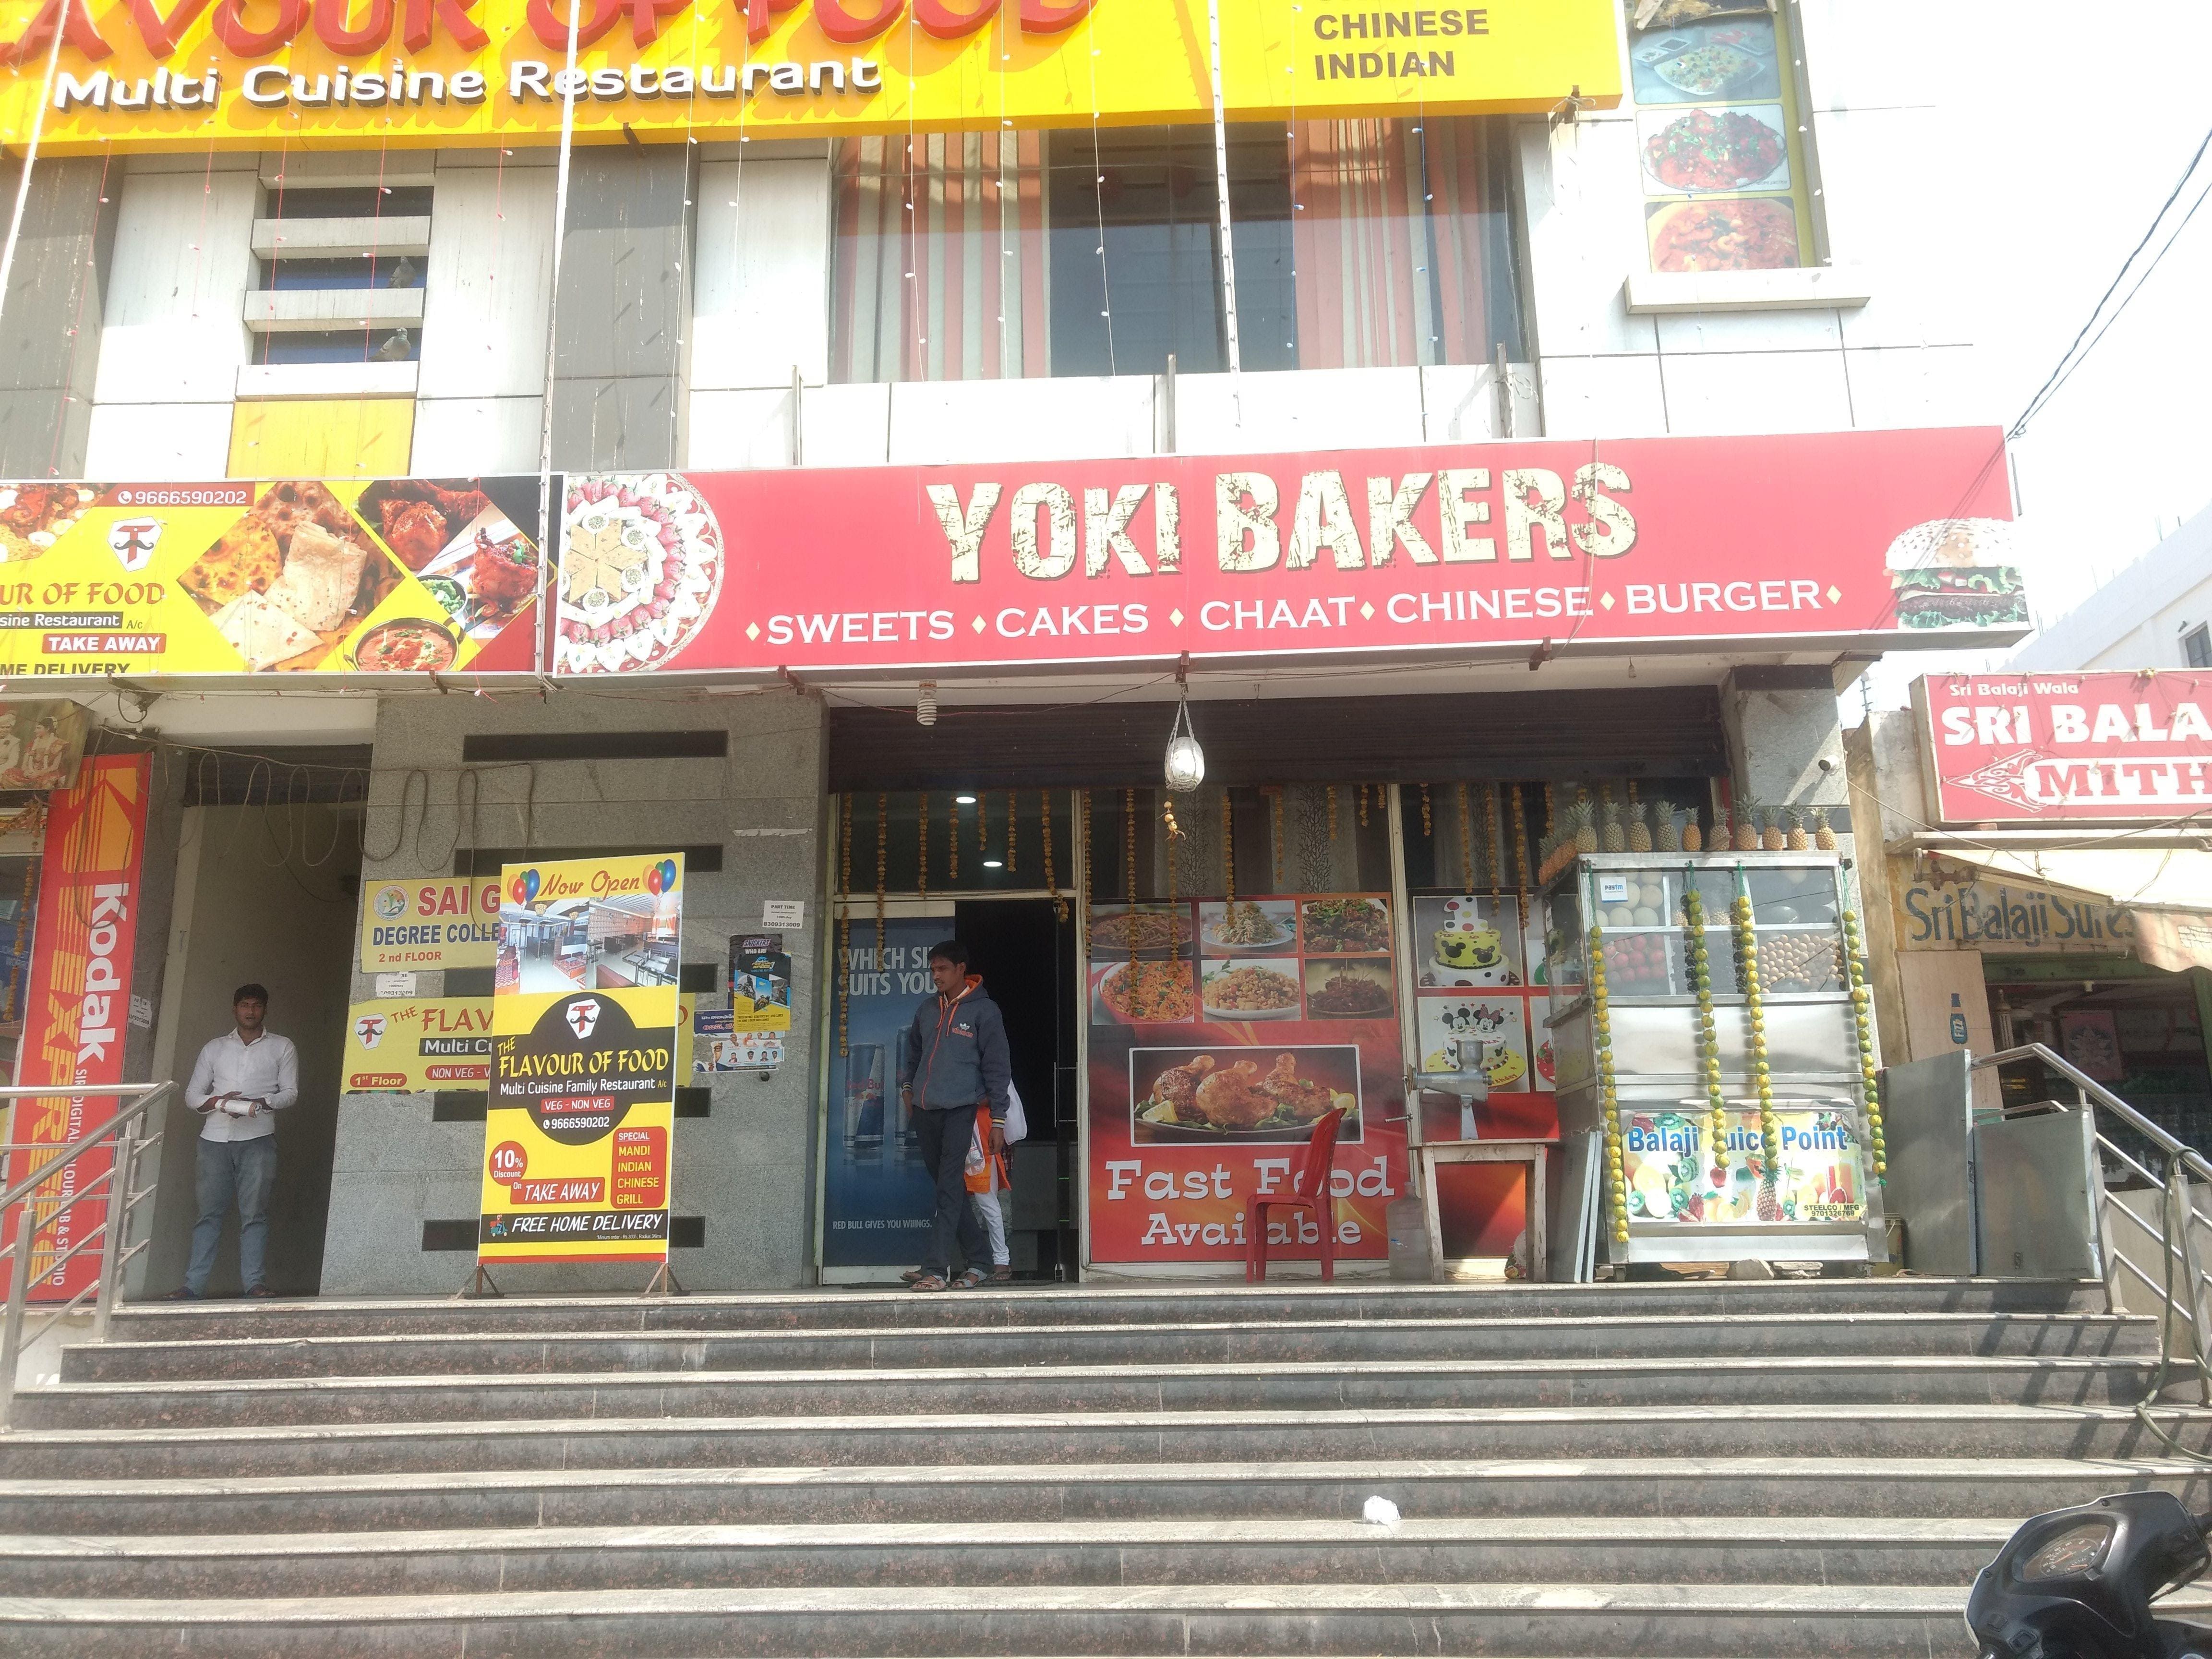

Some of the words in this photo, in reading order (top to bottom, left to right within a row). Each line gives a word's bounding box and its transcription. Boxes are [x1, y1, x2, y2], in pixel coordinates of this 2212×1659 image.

[1314, 9, 1489, 40] CHINESE
[1314, 50, 1456, 81] INDIAN
[54, 66, 221, 112] Multi
[242, 64, 487, 108] Cuisine
[508, 56, 882, 102] Restaurant
[135, 491, 247, 505] 9666590202
[926, 481, 1182, 584] YOKI
[1215, 461, 1637, 572] BAKERS
[0, 583, 34, 605] UR
[43, 582, 81, 605] OF
[86, 582, 166, 605] FOOD
[0, 614, 30, 626] sine
[35, 613, 120, 627] Restaurant
[126, 620, 143, 630] A/c
[767, 610, 955, 645] SWEETS
[995, 603, 1149, 637] CAKES
[1200, 595, 1357, 630] CHAAT
[1387, 586, 1593, 624] CHINESE
[1626, 579, 1822, 615] BURGER
[48, 637, 99, 651] TAKE
[105, 636, 161, 651] AWAY
[0, 663, 27, 675] ME
[34, 663, 131, 675] DELIVERY
[1949, 684, 1971, 697] Sri
[1978, 683, 2029, 698] Balaji
[2032, 682, 2079, 695] Wala
[1941, 706, 2032, 745] SRI
[2051, 702, 2212, 743] BALA
[2035, 763, 2212, 797] MITH
[540, 874, 584, 897] Now
[590, 870, 640, 901] Open
[417, 886, 470, 917] SAI
[1905, 887, 1955, 941] Sri
[1958, 888, 2049, 947] Balaji
[373, 925, 441, 946] DEGREE
[447, 923, 499, 943] COLLE
[378, 953, 385, 962] 2
[389, 952, 402, 962] nd
[405, 951, 442, 962] FLOOR
[838, 947, 905, 971] WHICH
[77, 883, 130, 1065] Kodak
[390, 1006, 418, 1023] THE
[421, 1008, 494, 1032] FLAV
[424, 1039, 469, 1054] Multi
[497, 1036, 516, 1056] THE
[432, 1069, 452, 1078] NON
[455, 1068, 474, 1078] VEG
[499, 1052, 585, 1078] FLAVOUR
[589, 1051, 614, 1074] OF
[617, 1048, 669, 1073] FOOD
[73, 1069, 87, 1092] SIR
[355, 1075, 369, 1086] 1st
[371, 1076, 402, 1086] Floor
[500, 1080, 525, 1096] Multi
[528, 1081, 563, 1094] Cuisine
[566, 1079, 598, 1096] Family
[601, 1078, 656, 1091] Restaurant
[658, 1080, 667, 1089] A/c
[545, 1100, 563, 1110] VEG
[571, 1099, 589, 1109] NON
[593, 1098, 611, 1108] VEG
[68, 1095, 84, 1143] DIGITAL
[552, 1117, 610, 1129] 9666590202
[618, 1132, 650, 1141] SPECIAL
[1628, 1126, 1699, 1159] Balaji
[1712, 1126, 1773, 1152] uic
[1782, 1125, 1848, 1151] Point
[494, 1149, 524, 1169] 10%
[619, 1145, 650, 1156] MANDI
[493, 1170, 522, 1178] Discount
[618, 1161, 651, 1172] INDIAN
[513, 1182, 522, 1190] On
[617, 1177, 659, 1189] CHINESE
[1105, 1160, 1233, 1201] Fast
[525, 1184, 558, 1202] TAKE
[560, 1181, 601, 1200] AWAY
[617, 1194, 644, 1205] GRILL
[57, 1225, 69, 1236] &
[512, 1216, 548, 1232] FREE
[550, 1215, 589, 1232] HOME
[592, 1214, 662, 1231] DELIVERY
[833, 1221, 846, 1229] RED
[848, 1220, 864, 1229] BULL
[865, 1220, 885, 1229] GIVES
[887, 1219, 901, 1228] YOU
[1141, 1211, 1362, 1246] Avaiabe
